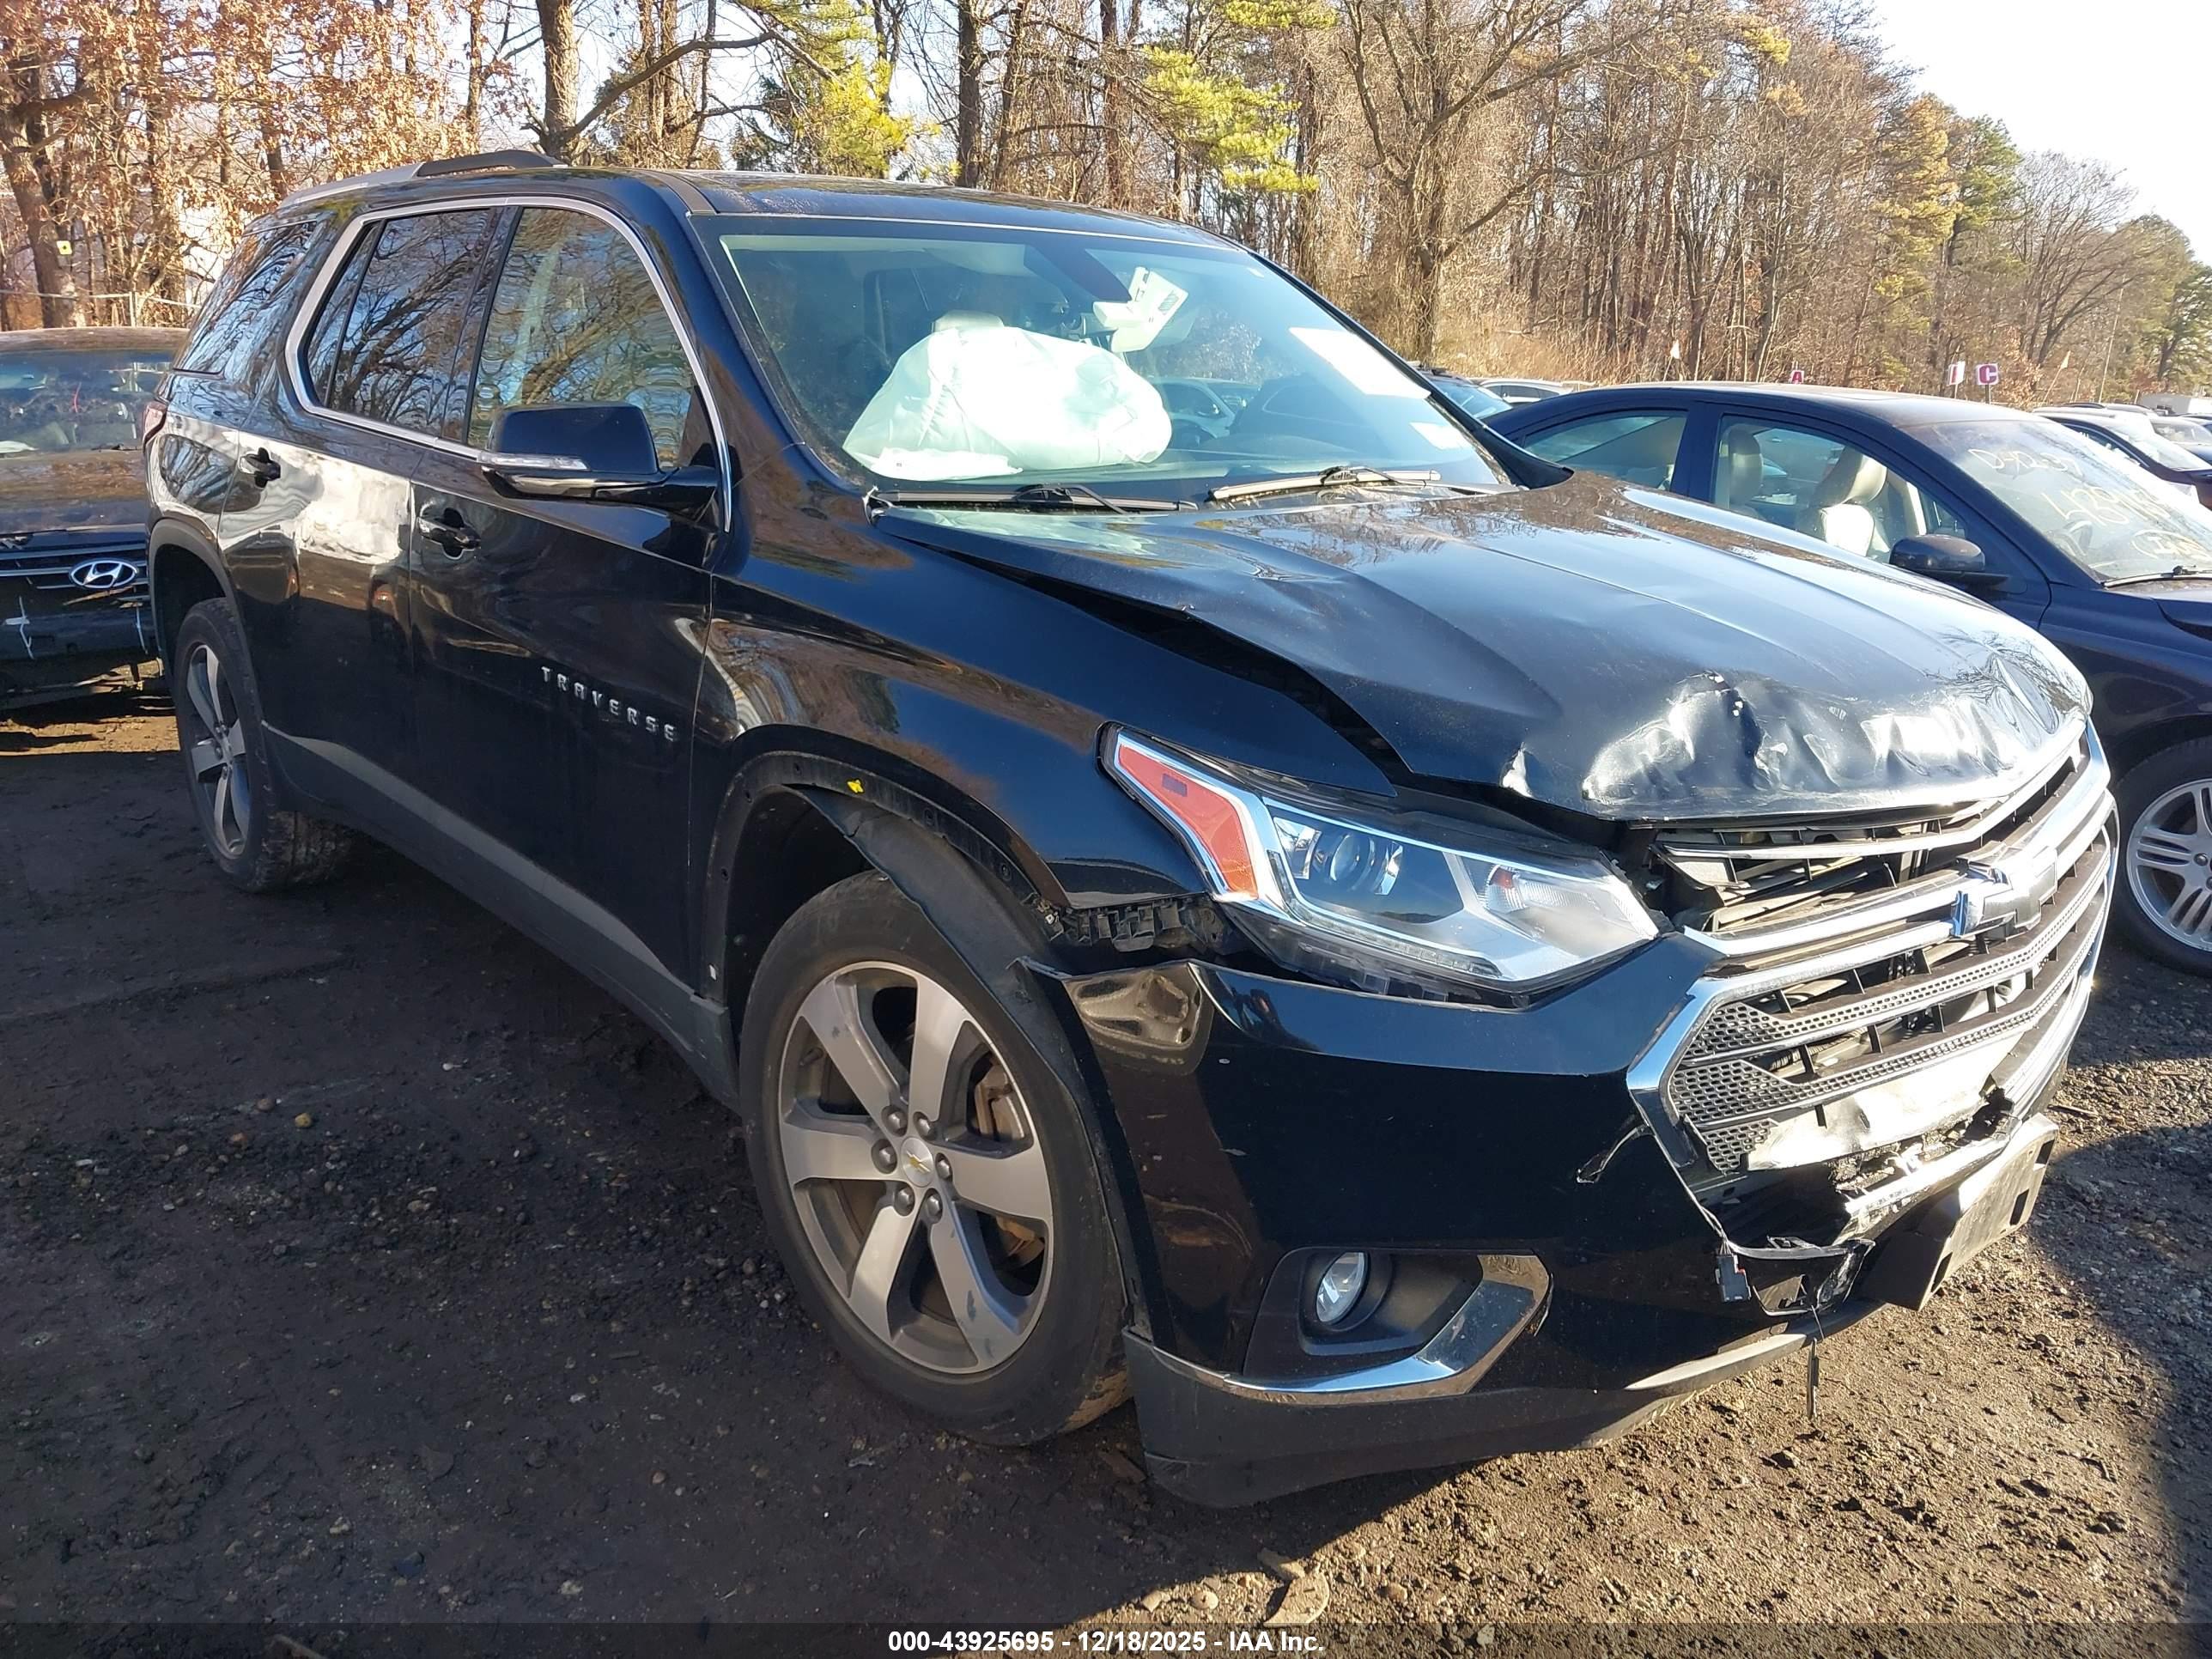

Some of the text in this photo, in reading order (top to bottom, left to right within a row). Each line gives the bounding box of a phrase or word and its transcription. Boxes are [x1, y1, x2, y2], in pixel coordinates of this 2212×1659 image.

[1791, 371, 1802, 383] A
[1979, 365, 1997, 384] C
[541, 665, 676, 742] TRAVERSE
